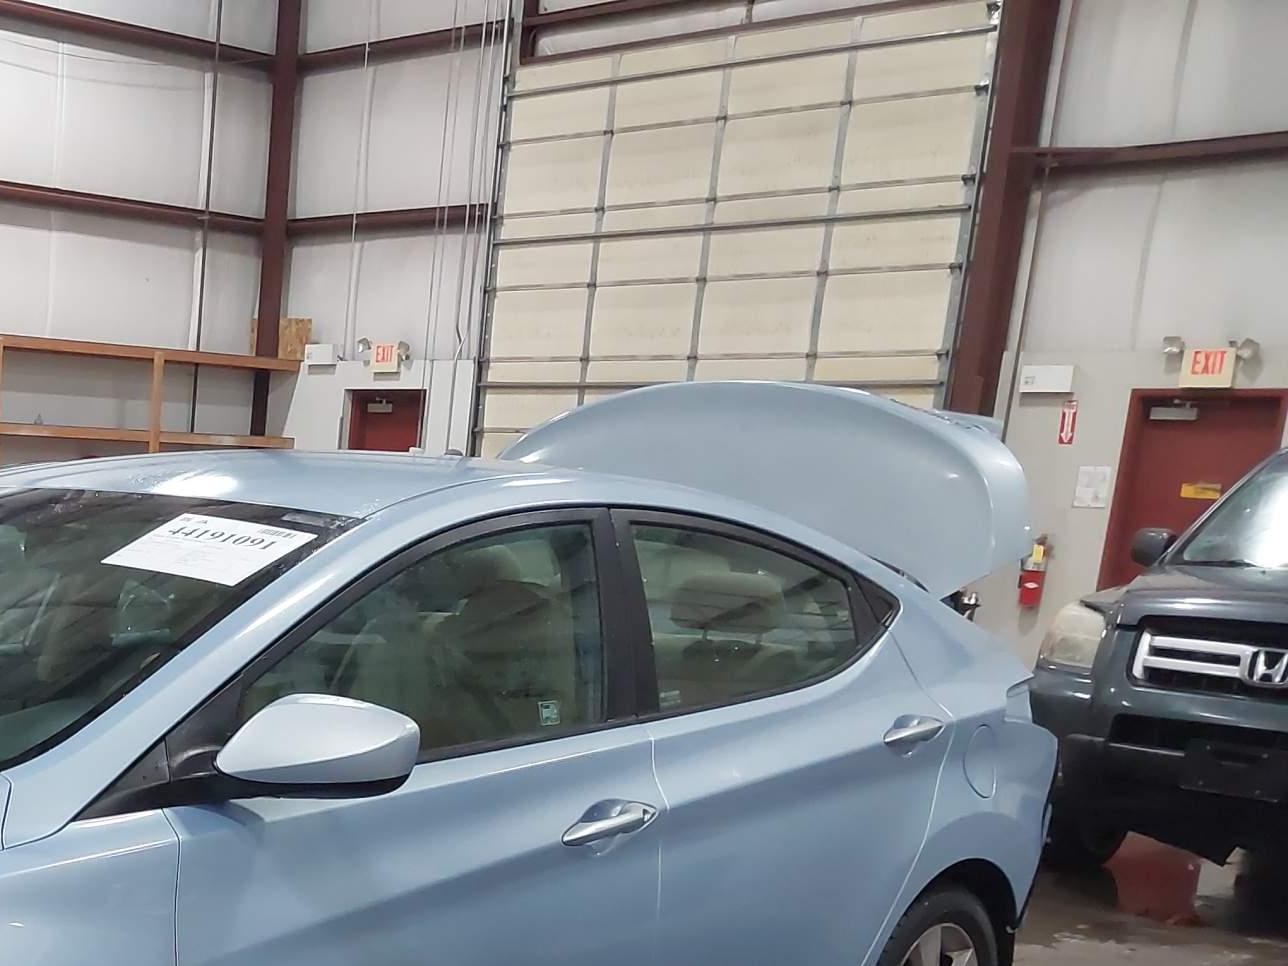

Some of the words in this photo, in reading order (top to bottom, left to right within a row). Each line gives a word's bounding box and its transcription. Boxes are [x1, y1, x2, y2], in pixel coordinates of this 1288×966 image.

[376, 345, 394, 362] EXIT
[1191, 350, 1227, 375] EXIT
[168, 526, 277, 550] 44191091
